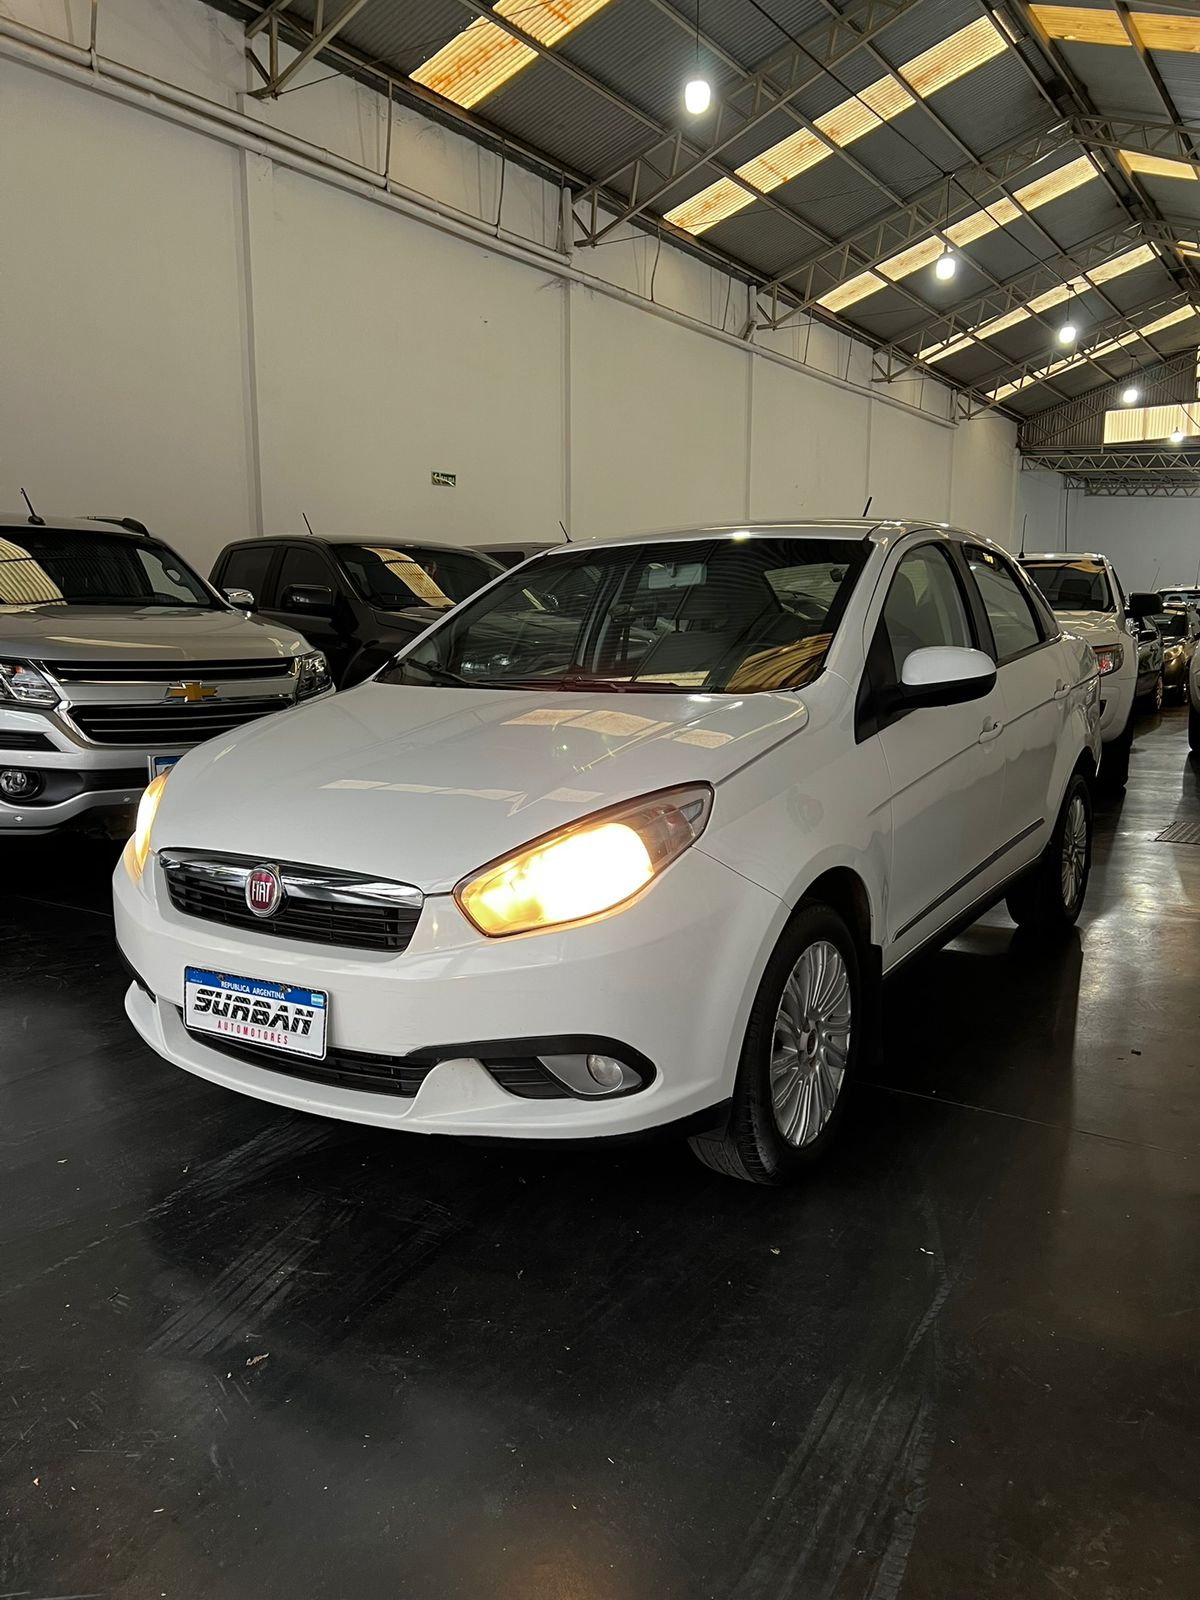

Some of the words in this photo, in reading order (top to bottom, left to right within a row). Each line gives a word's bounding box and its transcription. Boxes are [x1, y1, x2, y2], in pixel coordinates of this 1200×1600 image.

[252, 880, 272, 902] FIAT
[221, 981, 250, 993] REPUBLICA
[252, 987, 285, 1000] ARGENTINA
[194, 988, 314, 1035] SURBAN
[217, 1020, 288, 1045] AUTOMOTORES
